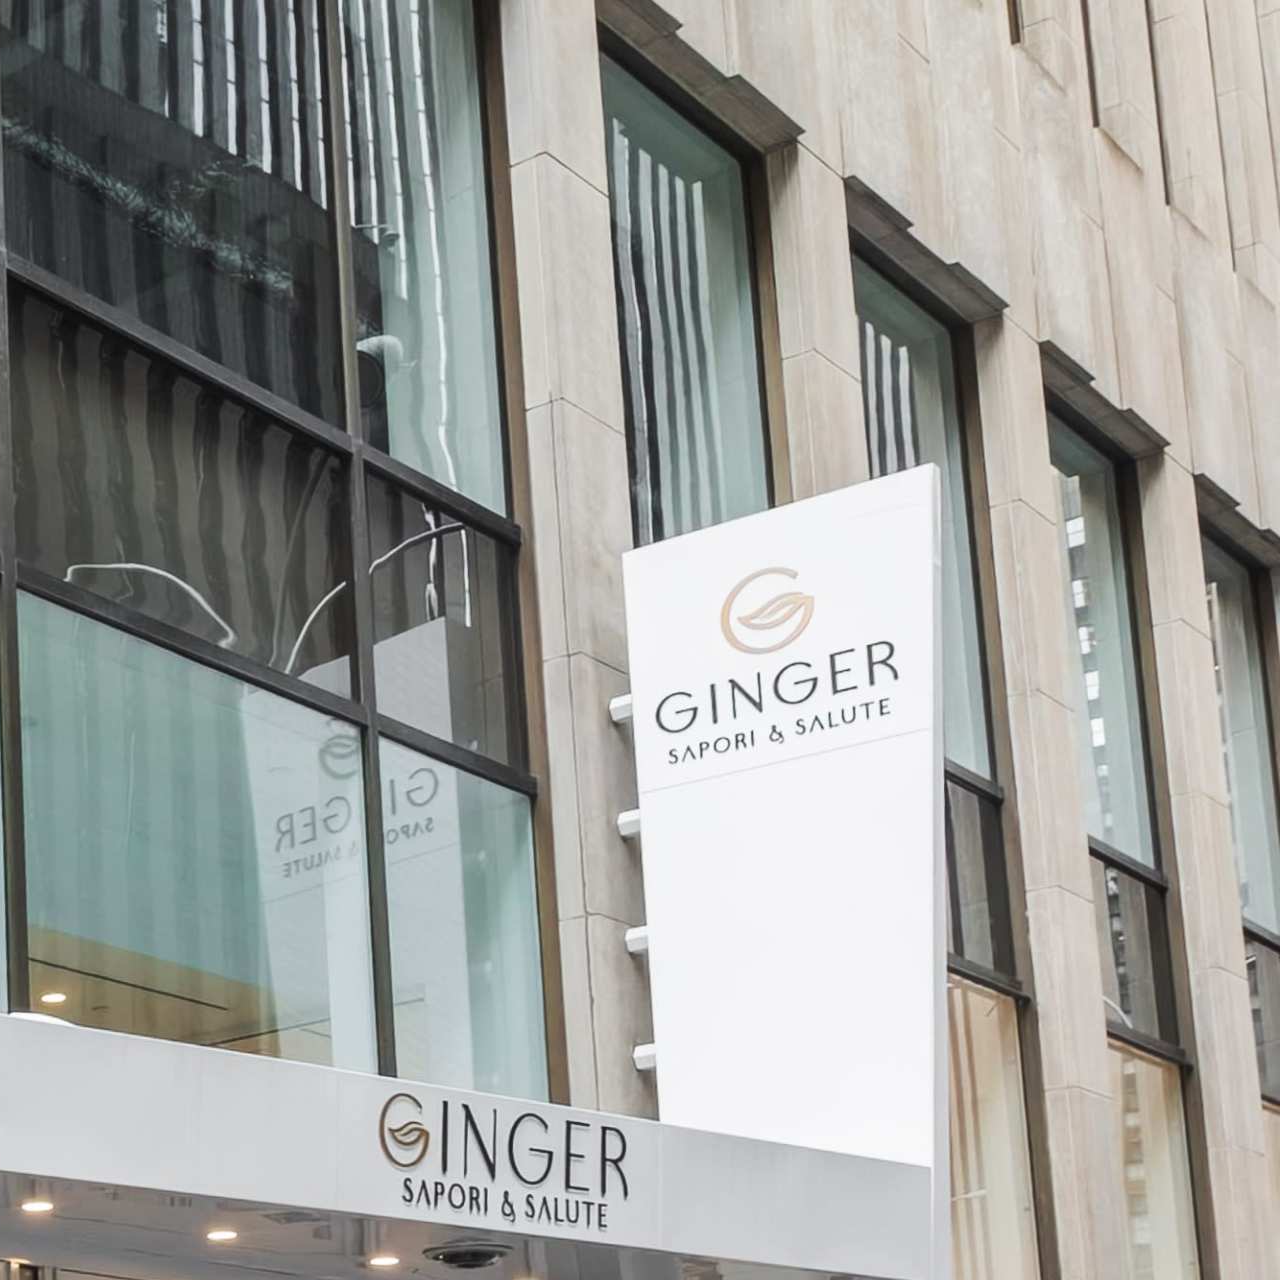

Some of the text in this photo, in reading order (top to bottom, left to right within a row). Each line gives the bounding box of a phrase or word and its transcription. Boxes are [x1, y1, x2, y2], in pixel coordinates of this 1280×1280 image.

[655, 640, 900, 734] GINGER
[667, 697, 892, 765] SAPORI & SALUTE
[378, 1092, 629, 1201] GINGER
[401, 1176, 609, 1230] SAPORI & SALUTE
